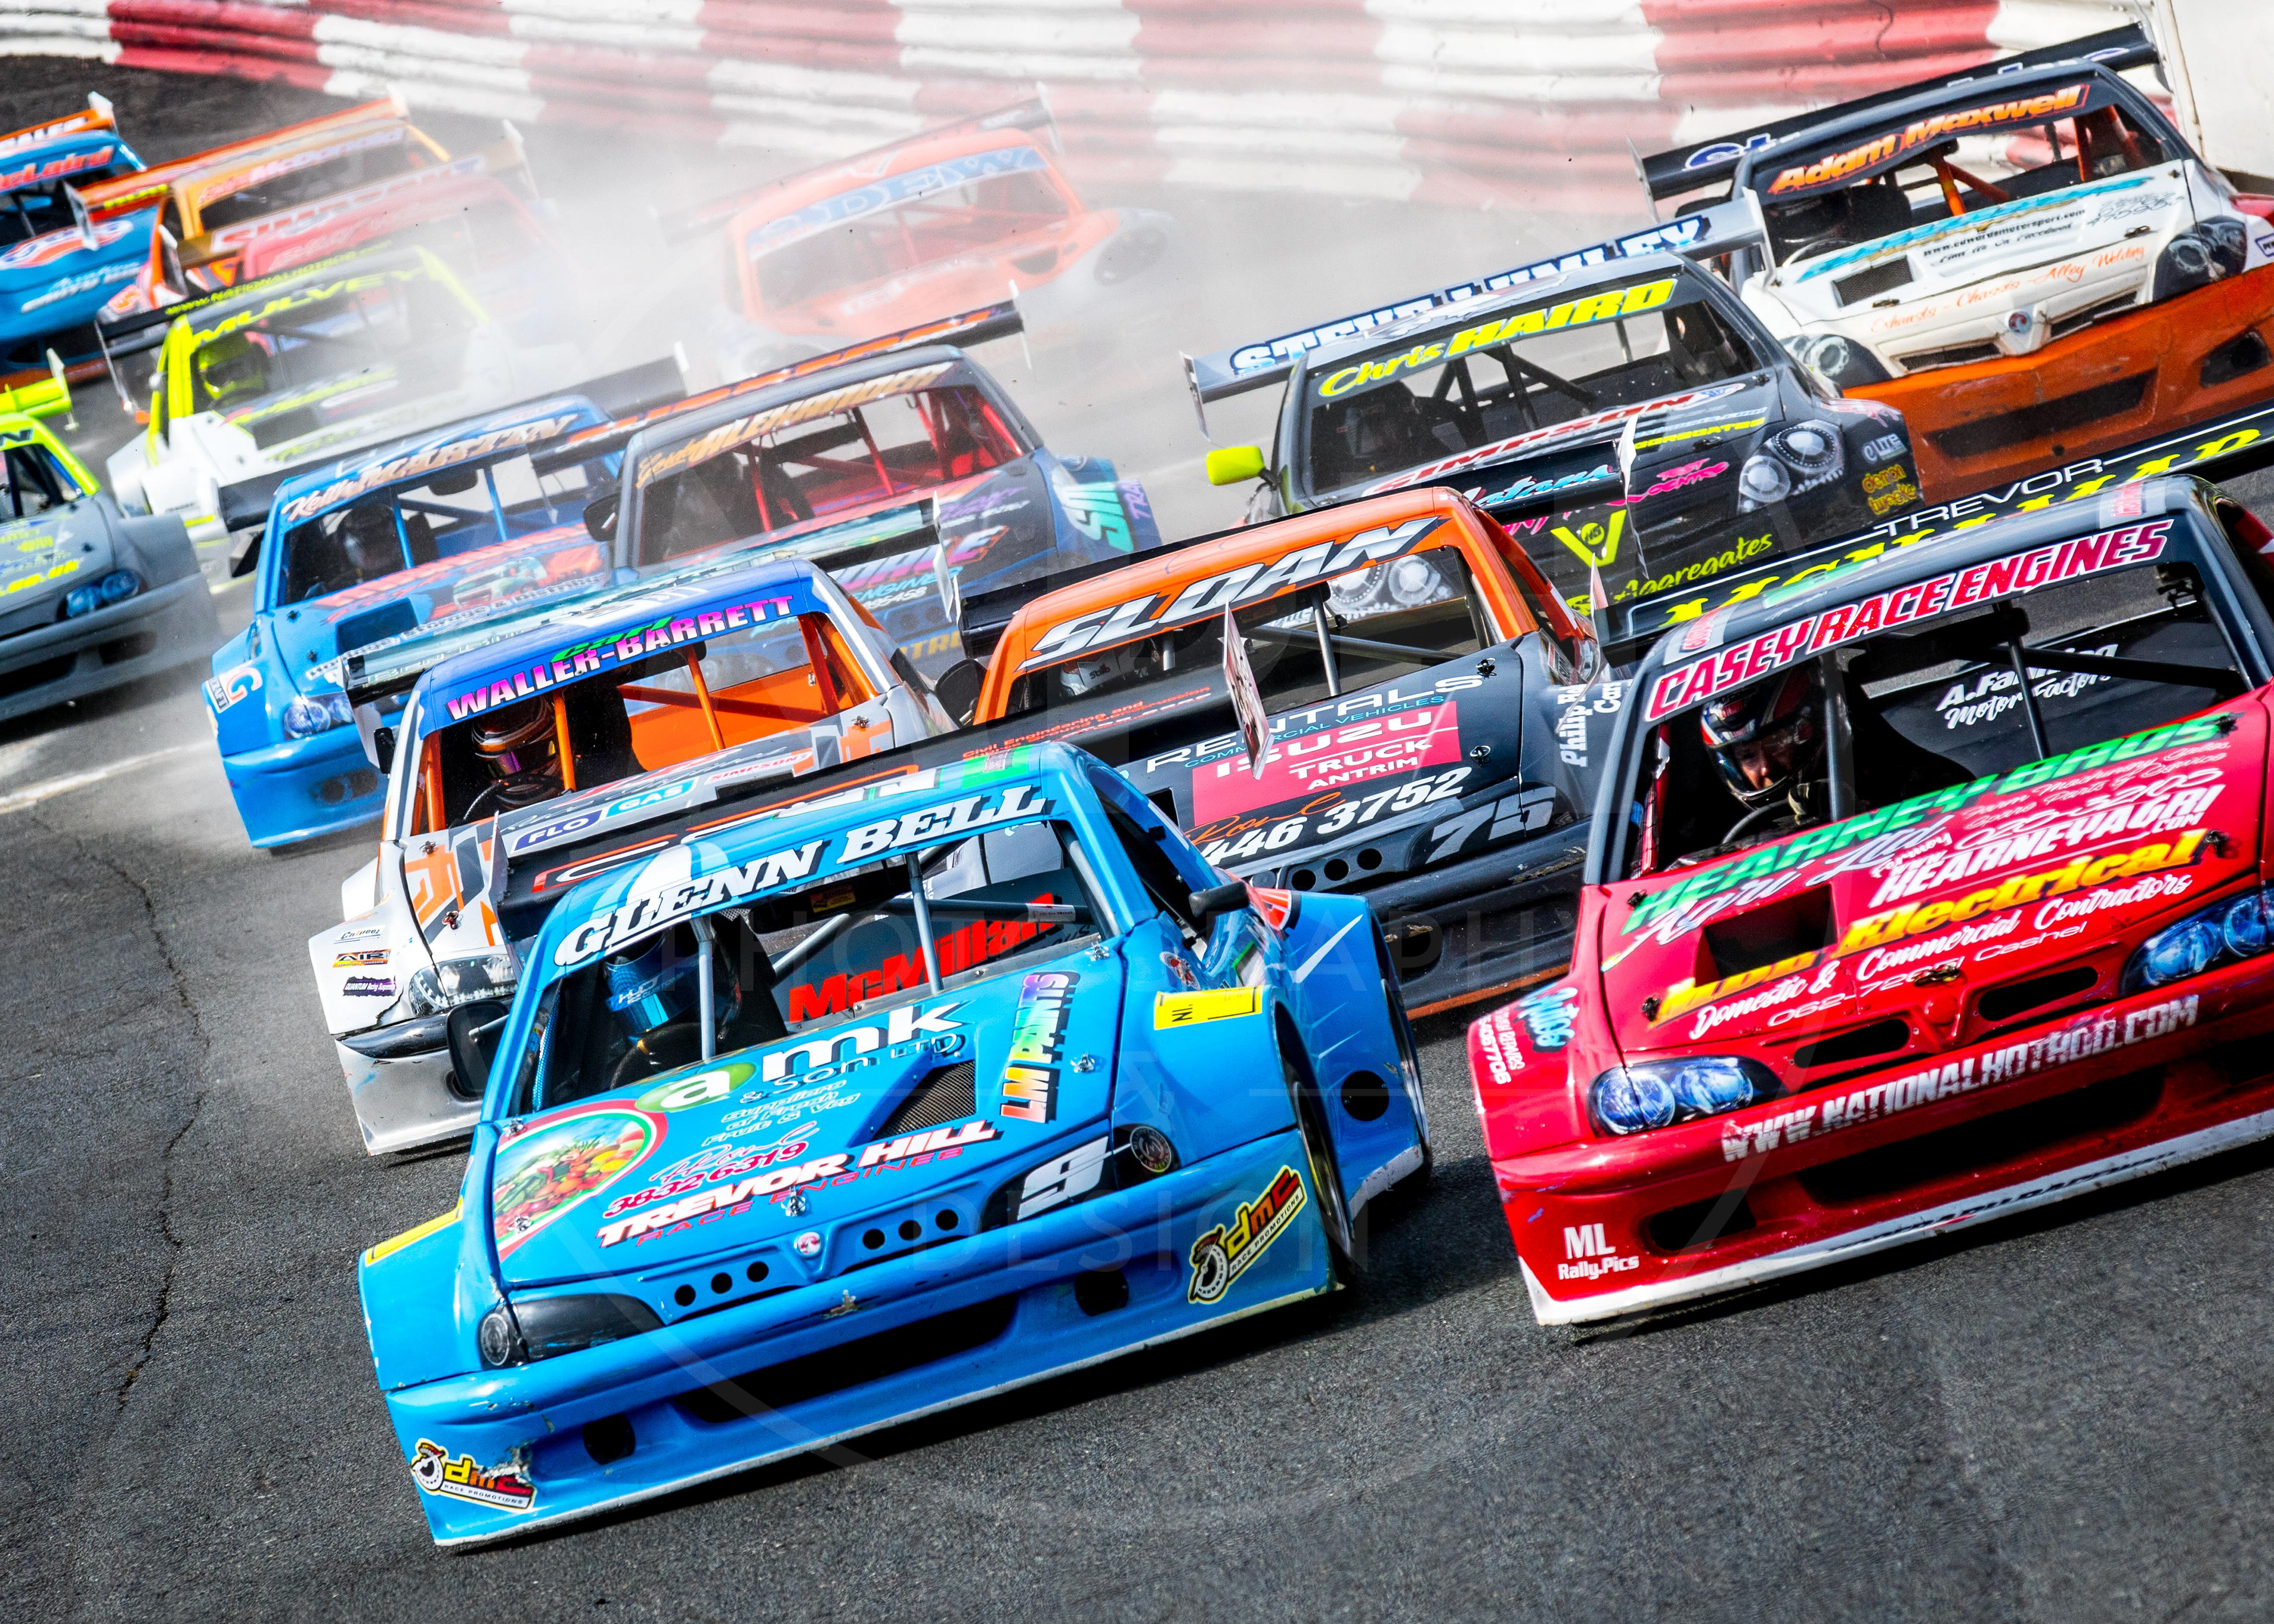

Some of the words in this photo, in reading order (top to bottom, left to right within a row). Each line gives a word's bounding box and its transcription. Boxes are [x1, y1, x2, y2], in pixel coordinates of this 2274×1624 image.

[1772, 135, 1897, 194] Adam
[1904, 85, 2087, 148] Maxwell
[1319, 342, 1446, 398] Chris
[1445, 278, 1678, 360] HAIRD
[1870, 303, 1938, 334] Exhausts
[1956, 278, 2021, 310] Chassis
[1370, 393, 1698, 495] SIMPSON
[1861, 463, 1907, 493] demon
[1874, 457, 2105, 536] TREVOR
[1017, 515, 1443, 670] SLOAN
[1646, 622, 1813, 723] CASEY
[1807, 573, 1954, 655] RACE
[1947, 519, 2175, 607] ENGINES
[446, 594, 794, 721] WALLER-BARRETT
[962, 742, 997, 758] Civil
[1112, 700, 1144, 715] and
[1335, 694, 1446, 728] VEHICLES
[1944, 691, 2024, 729] Motor
[708, 754, 800, 782] SIMPSON
[1288, 738, 1435, 780] TRUCK
[1307, 756, 1419, 792] ANTRIM
[528, 818, 589, 845] FLO
[618, 783, 685, 811] GAS
[1316, 766, 1473, 835] 3752
[1425, 787, 1556, 863] 75
[1621, 774, 1999, 935] HEARNEY
[1996, 713, 2229, 796] BROS
[2150, 811, 2205, 835] .COM
[554, 840, 823, 969] GLENN
[836, 784, 1049, 866] BELL
[1868, 784, 2227, 909] HEARNEYAGRI
[1831, 828, 2212, 960] Electrical
[1690, 978, 1813, 1041] Domestic
[1807, 959, 1841, 994] &
[1856, 903, 2021, 981] Commercial
[2034, 874, 2193, 931] Contractors
[1971, 921, 2089, 963] Cashel
[1007, 971, 1070, 1066] PAINTS
[1498, 1030, 1526, 1071] REPAIRS
[660, 1003, 964, 1108] amk
[772, 1055, 870, 1095] Son
[701, 1120, 772, 1147] Fruit
[776, 1111, 802, 1124] &
[810, 1092, 862, 1115] Veg
[721, 1079, 847, 1123] Suppliers
[725, 1114, 757, 1132] of
[759, 1091, 840, 1122] Fresh
[1000, 1065, 1049, 1124] LM
[595, 1153, 849, 1248] TREVOR
[860, 1118, 998, 1165] HILL
[602, 1172, 705, 1218] 3832
[706, 1140, 810, 1184] 6319
[637, 1199, 752, 1247] RACE
[769, 1145, 966, 1212] ENGINES
[1016, 1136, 1132, 1221] 9
[1226, 1170, 1299, 1260] dmc
[1231, 1249, 1252, 1272] RACE
[1254, 1194, 1300, 1249] PROMOTIONS
[1565, 1223, 1614, 1260] ML
[1557, 1254, 1640, 1282] Rally.Pics
[444, 1484, 464, 1493] RACE
[468, 1488, 525, 1505] PROMOTIONS
